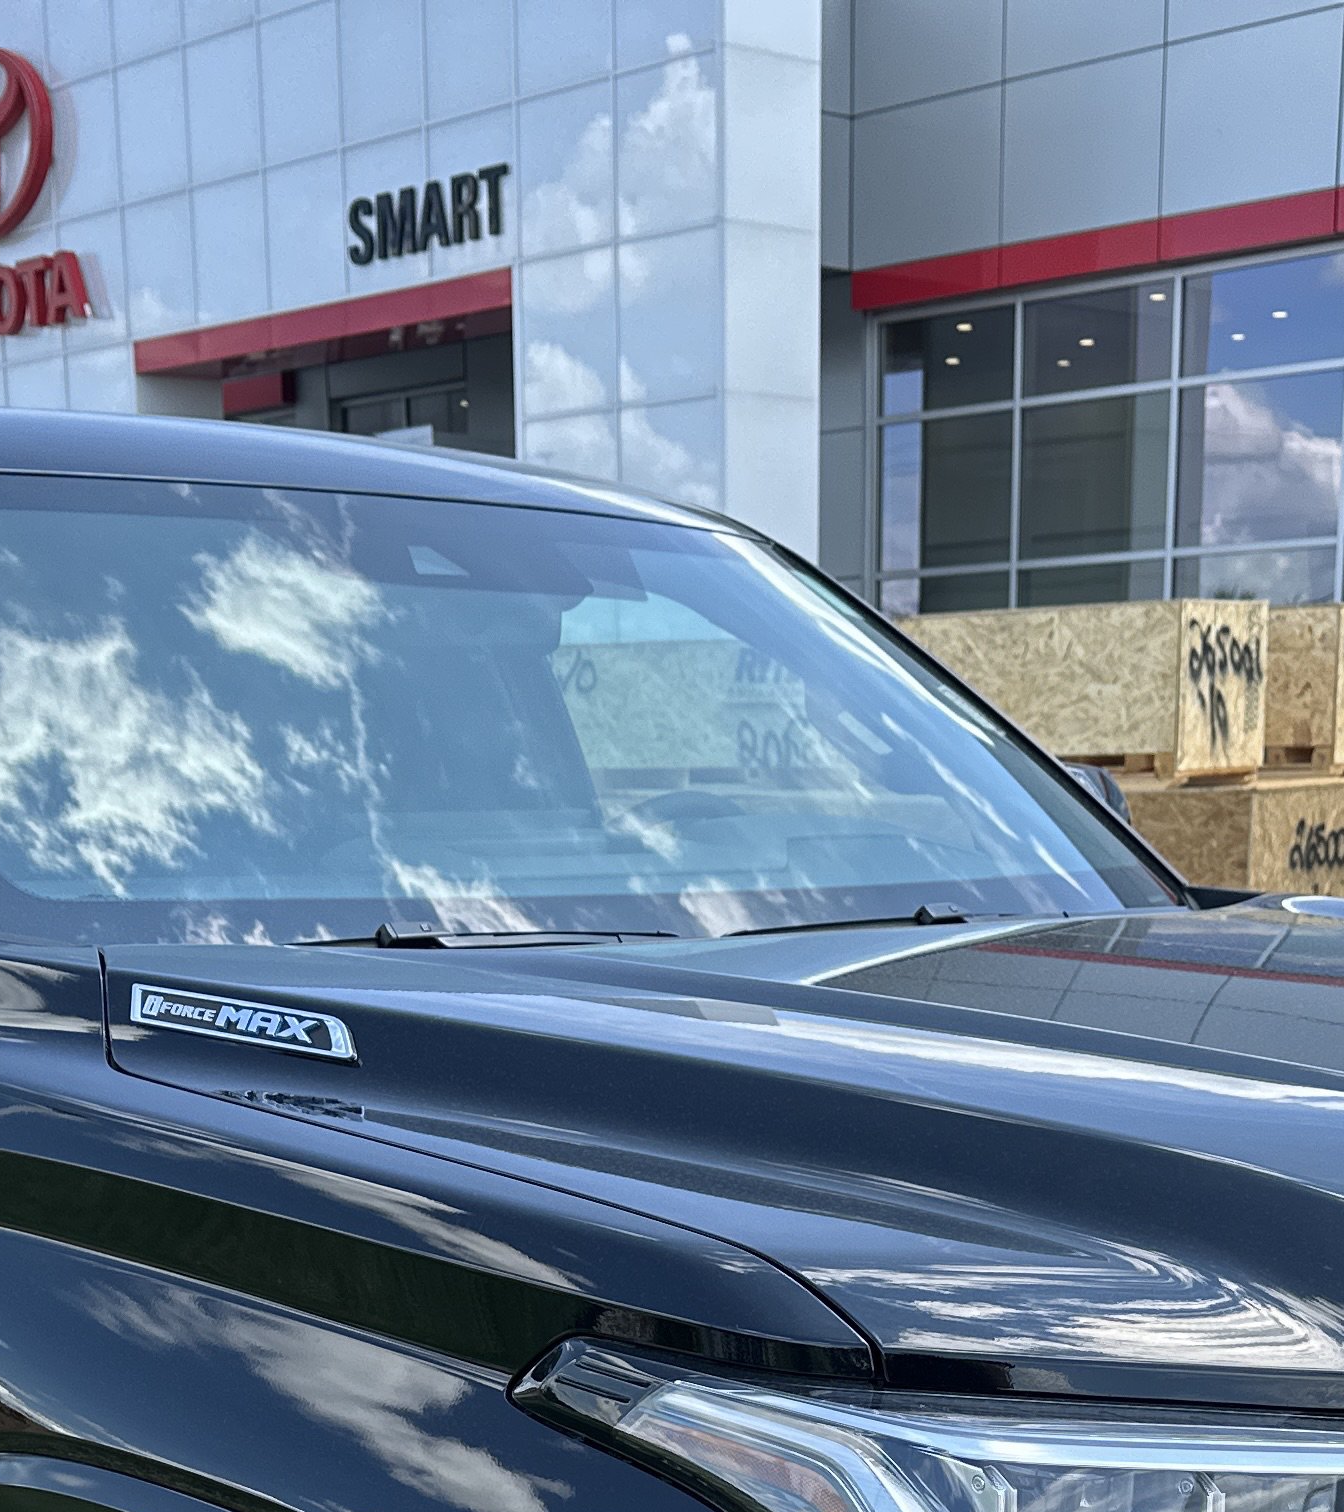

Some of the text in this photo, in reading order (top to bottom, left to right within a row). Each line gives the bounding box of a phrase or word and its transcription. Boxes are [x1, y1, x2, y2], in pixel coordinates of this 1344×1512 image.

[349, 163, 510, 266] SMART
[1189, 618, 1263, 684] 265001
[215, 1006, 324, 1044] MAX
